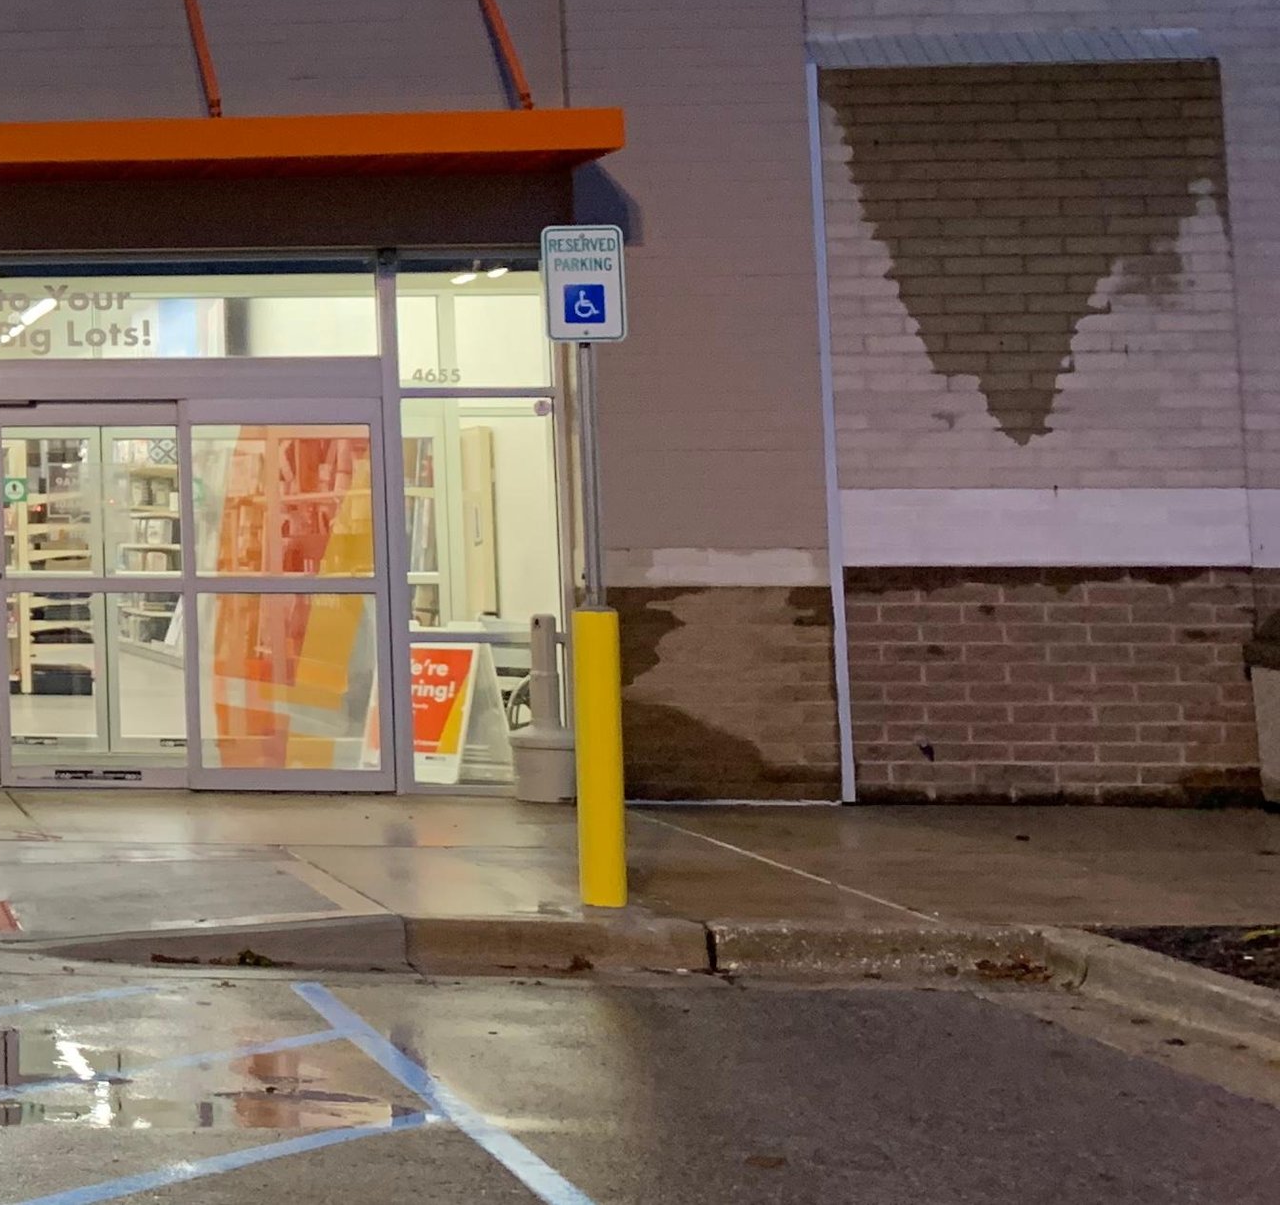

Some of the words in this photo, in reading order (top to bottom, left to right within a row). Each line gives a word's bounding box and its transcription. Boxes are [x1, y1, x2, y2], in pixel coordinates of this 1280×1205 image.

[548, 237, 616, 253] RESERVED
[554, 257, 613, 272] PARKING
[43, 284, 131, 311] Your
[66, 319, 151, 347] Lots!
[412, 367, 461, 383] 4655
[410, 658, 449, 677] e're
[411, 679, 455, 702] ring!
